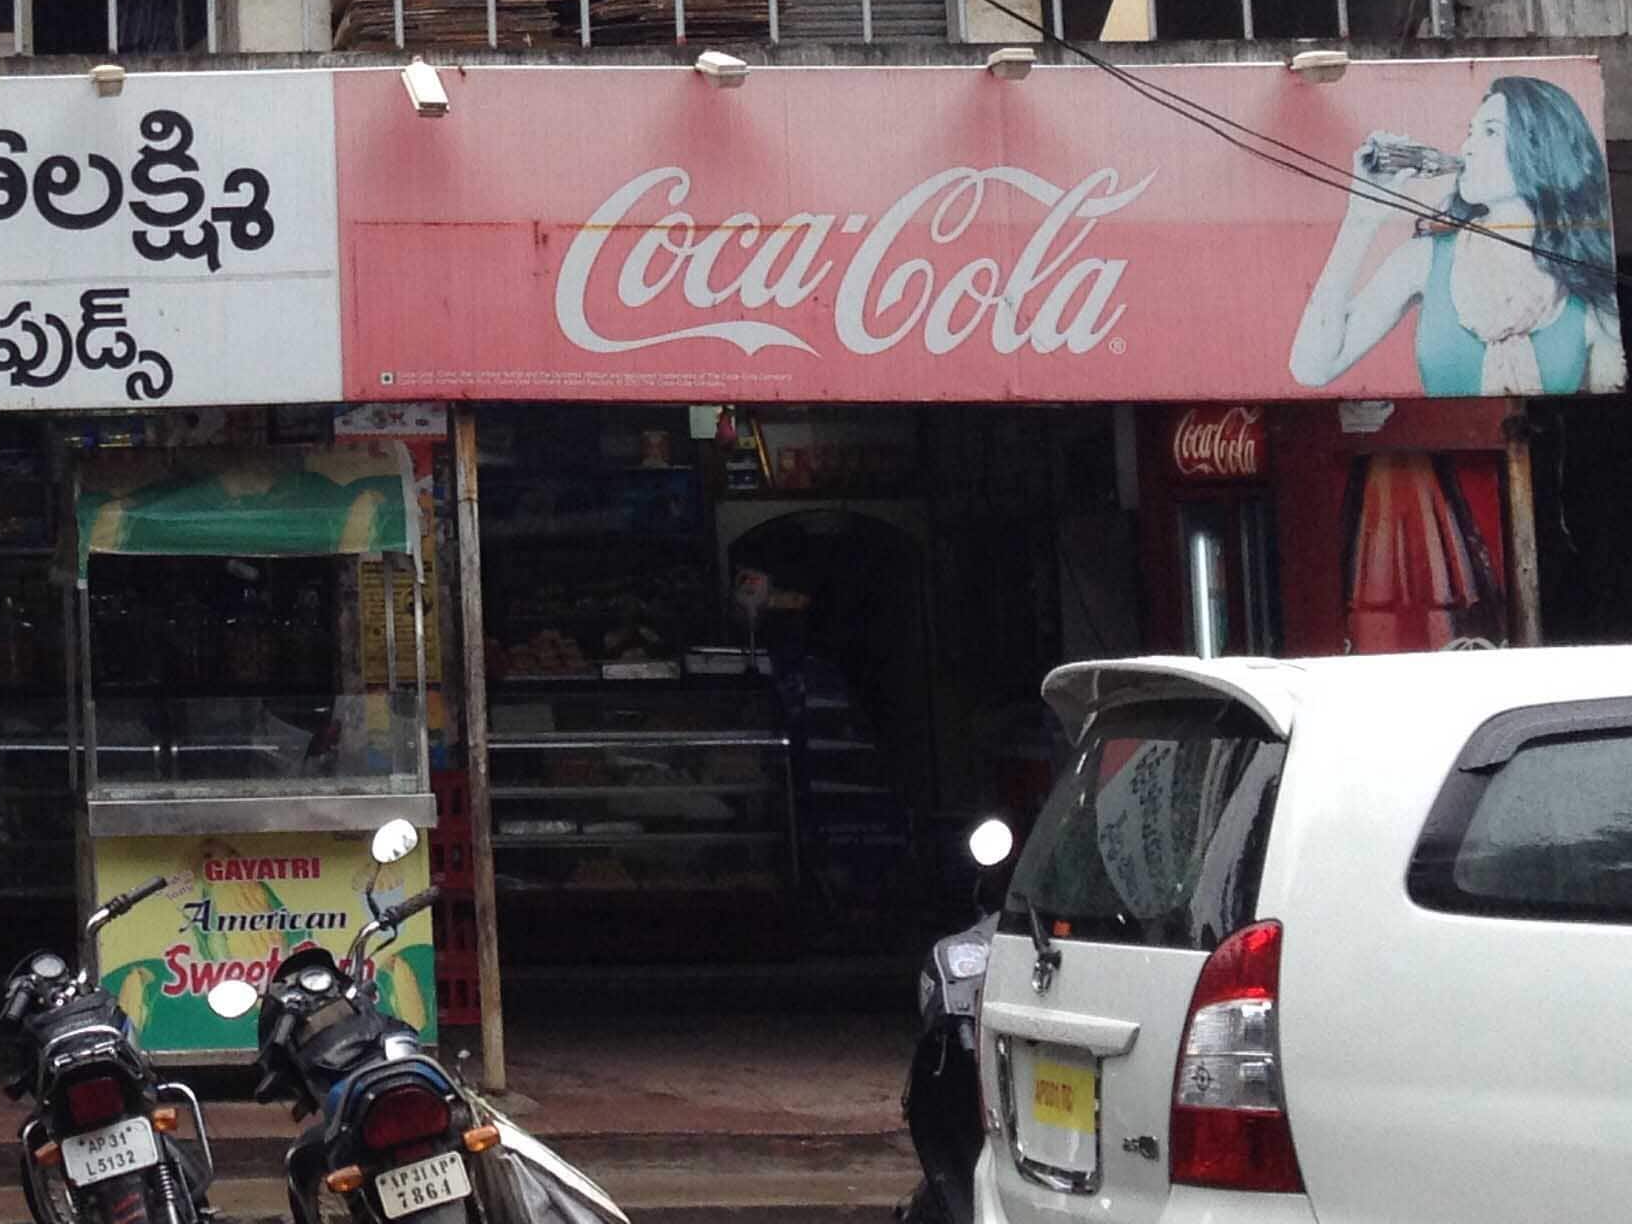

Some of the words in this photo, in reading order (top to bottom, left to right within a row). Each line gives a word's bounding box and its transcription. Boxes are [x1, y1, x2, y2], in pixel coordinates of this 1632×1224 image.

[555, 166, 1159, 356] Coca-Cola
[204, 856, 321, 882] GAYATRI
[179, 899, 347, 934] American
[85, 1150, 137, 1177] L5132
